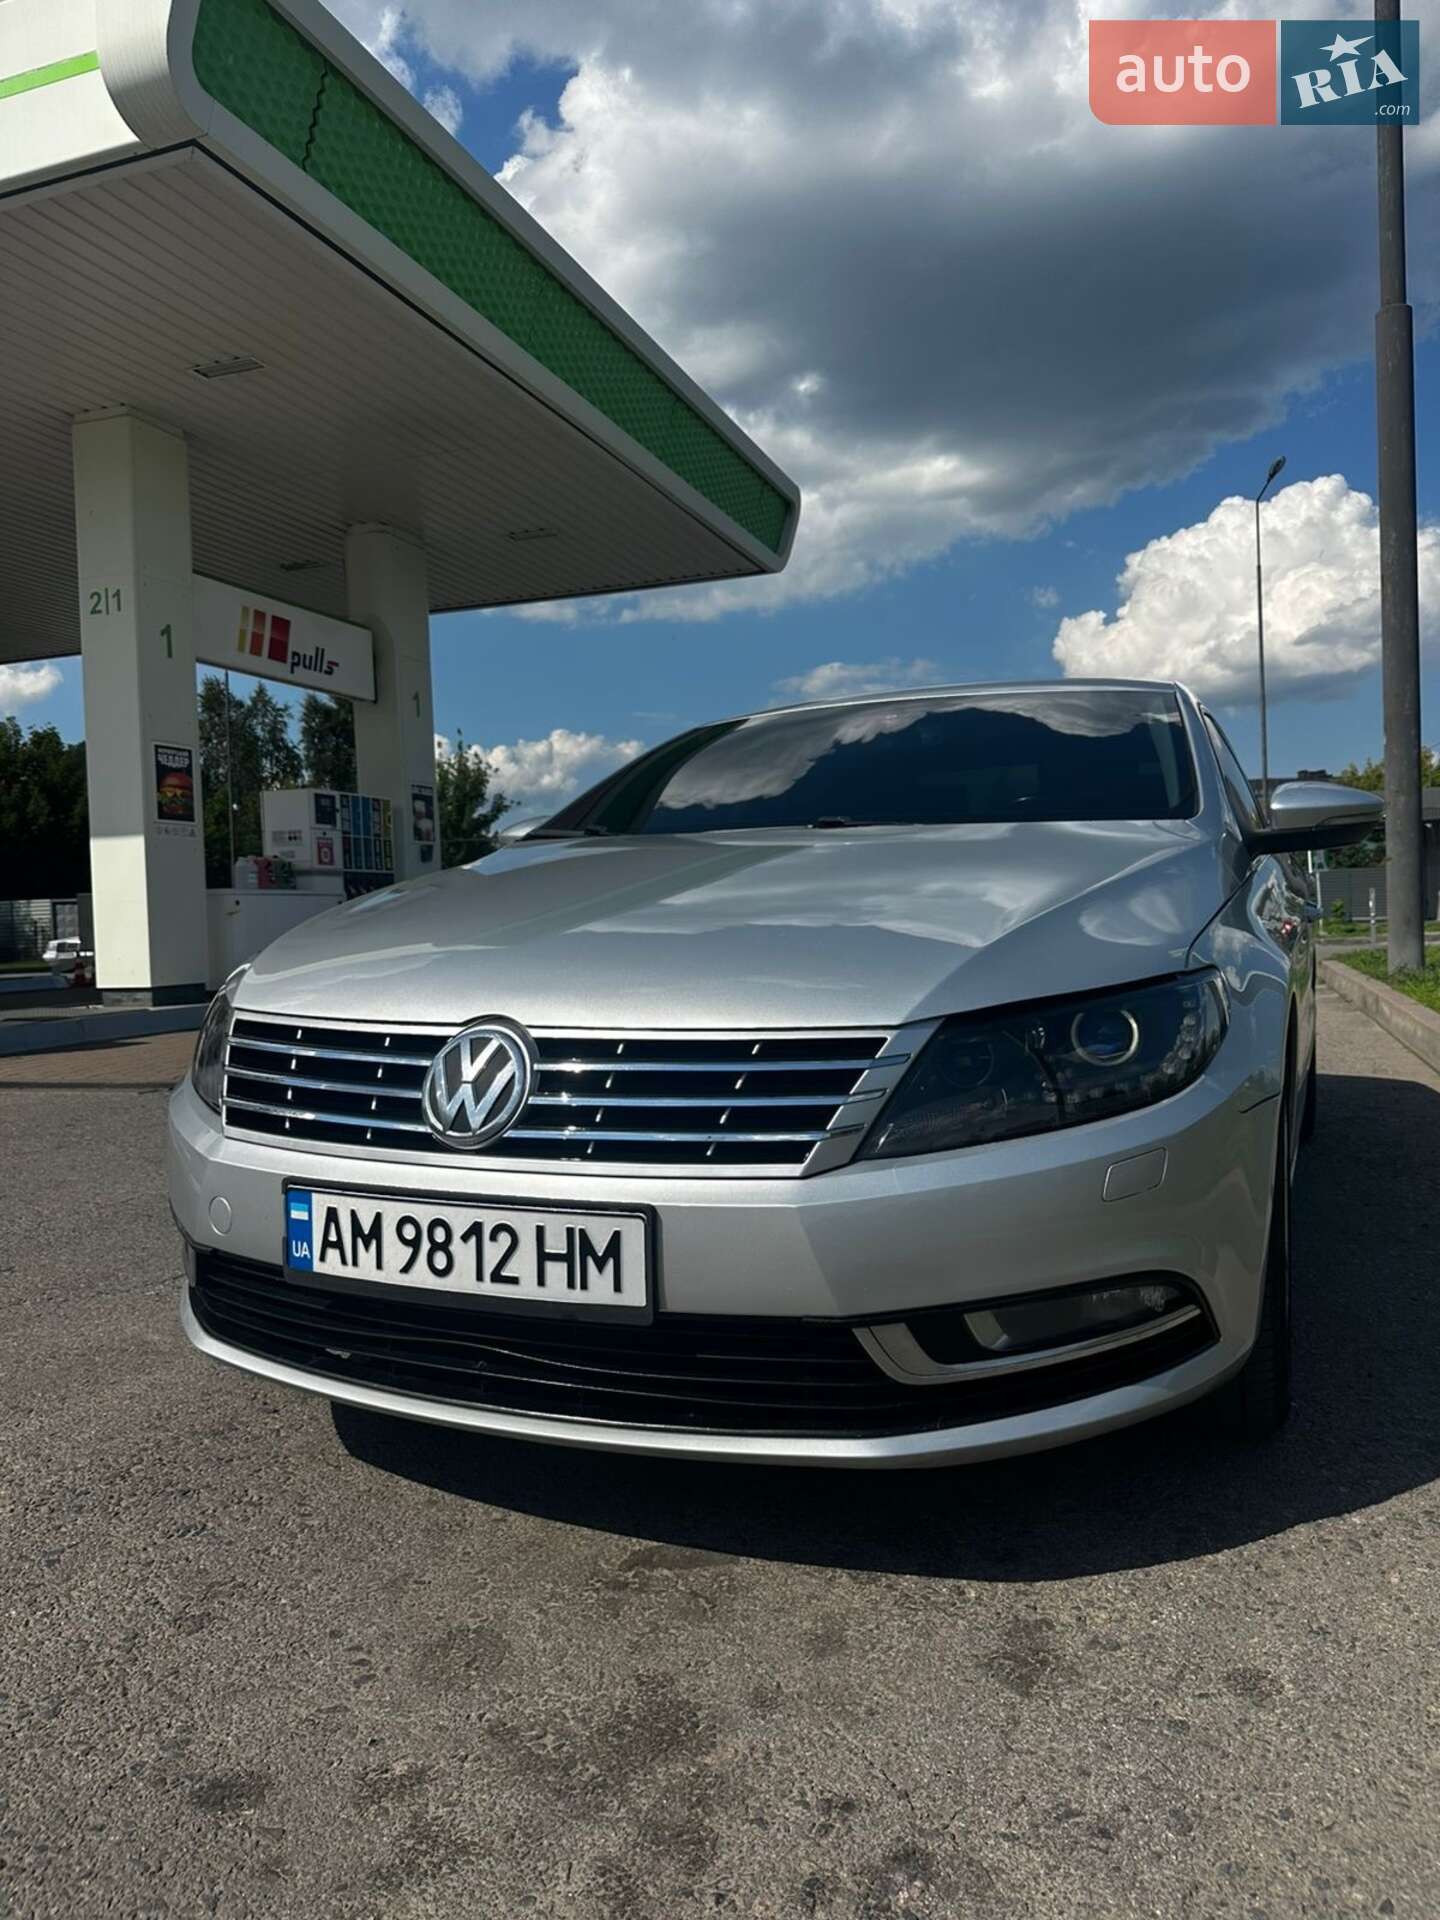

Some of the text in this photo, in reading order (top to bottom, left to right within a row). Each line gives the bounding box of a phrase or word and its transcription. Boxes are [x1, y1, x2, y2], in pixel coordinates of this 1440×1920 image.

[160, 623, 174, 659] 1
[290, 645, 340, 676] pulls
[412, 690, 421, 719] 1
[292, 1239, 311, 1260] UA
[318, 1204, 622, 1294] AM 9812 HM
